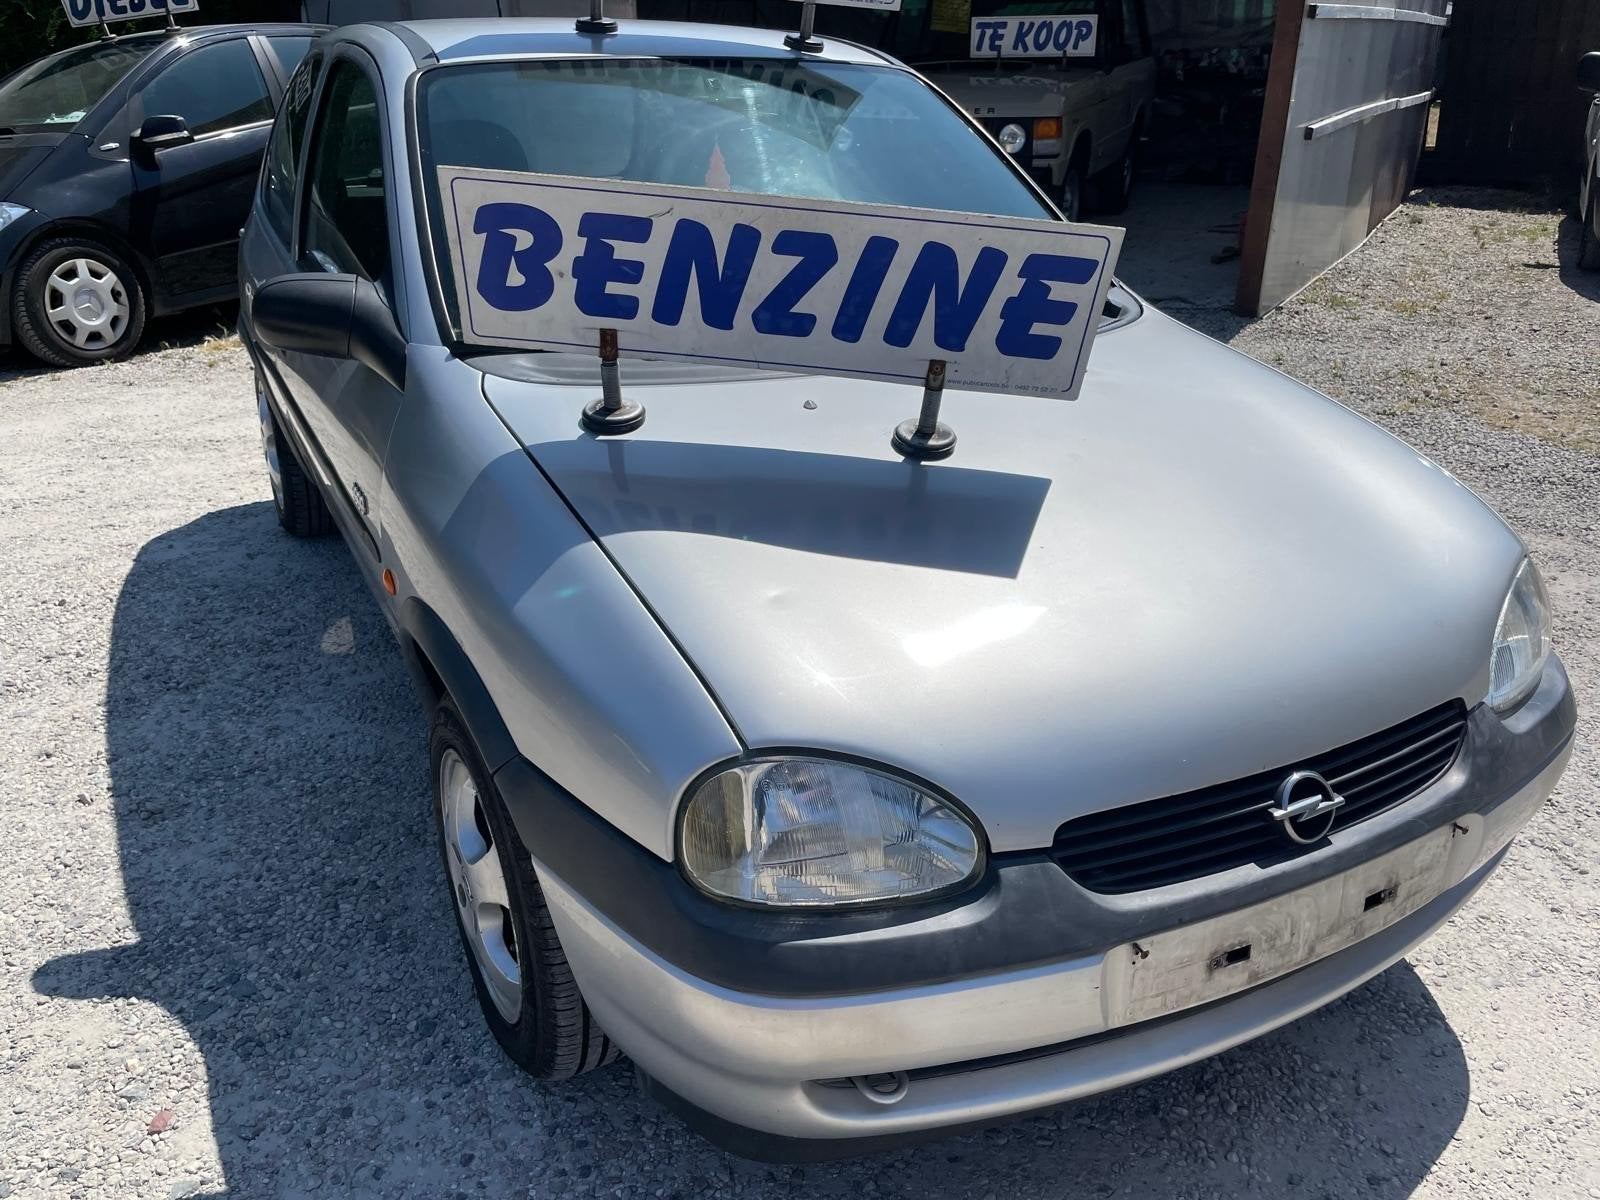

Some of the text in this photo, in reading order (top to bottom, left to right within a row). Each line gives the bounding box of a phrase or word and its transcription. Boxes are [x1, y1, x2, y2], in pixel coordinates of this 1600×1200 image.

[975, 20, 1093, 52] TE KOOP
[473, 202, 1100, 360] BENZINE
